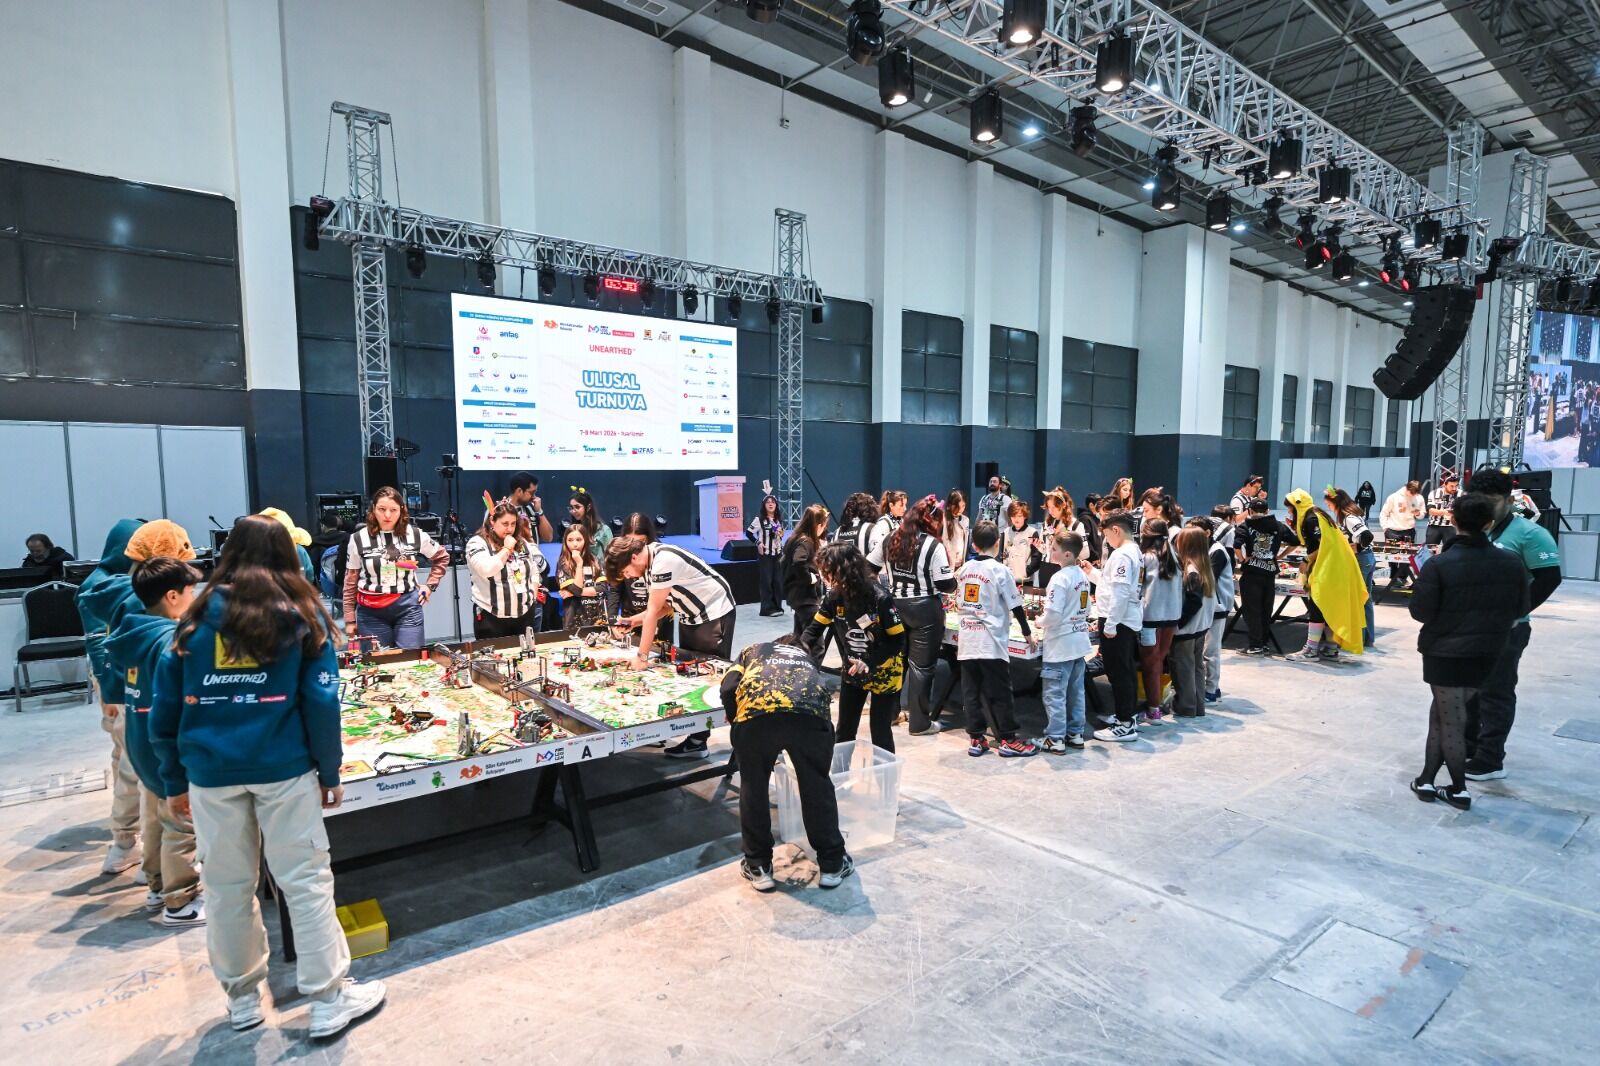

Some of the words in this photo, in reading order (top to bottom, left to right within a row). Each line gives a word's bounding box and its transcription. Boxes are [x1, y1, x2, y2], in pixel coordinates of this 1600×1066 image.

[589, 344, 633, 355] UNEARTHED
[582, 370, 640, 390] ULUSAL
[576, 390, 647, 411] TURNUVA
[203, 672, 267, 686] UNEARTHED
[581, 745, 592, 759] A
[384, 778, 417, 791] baymak
